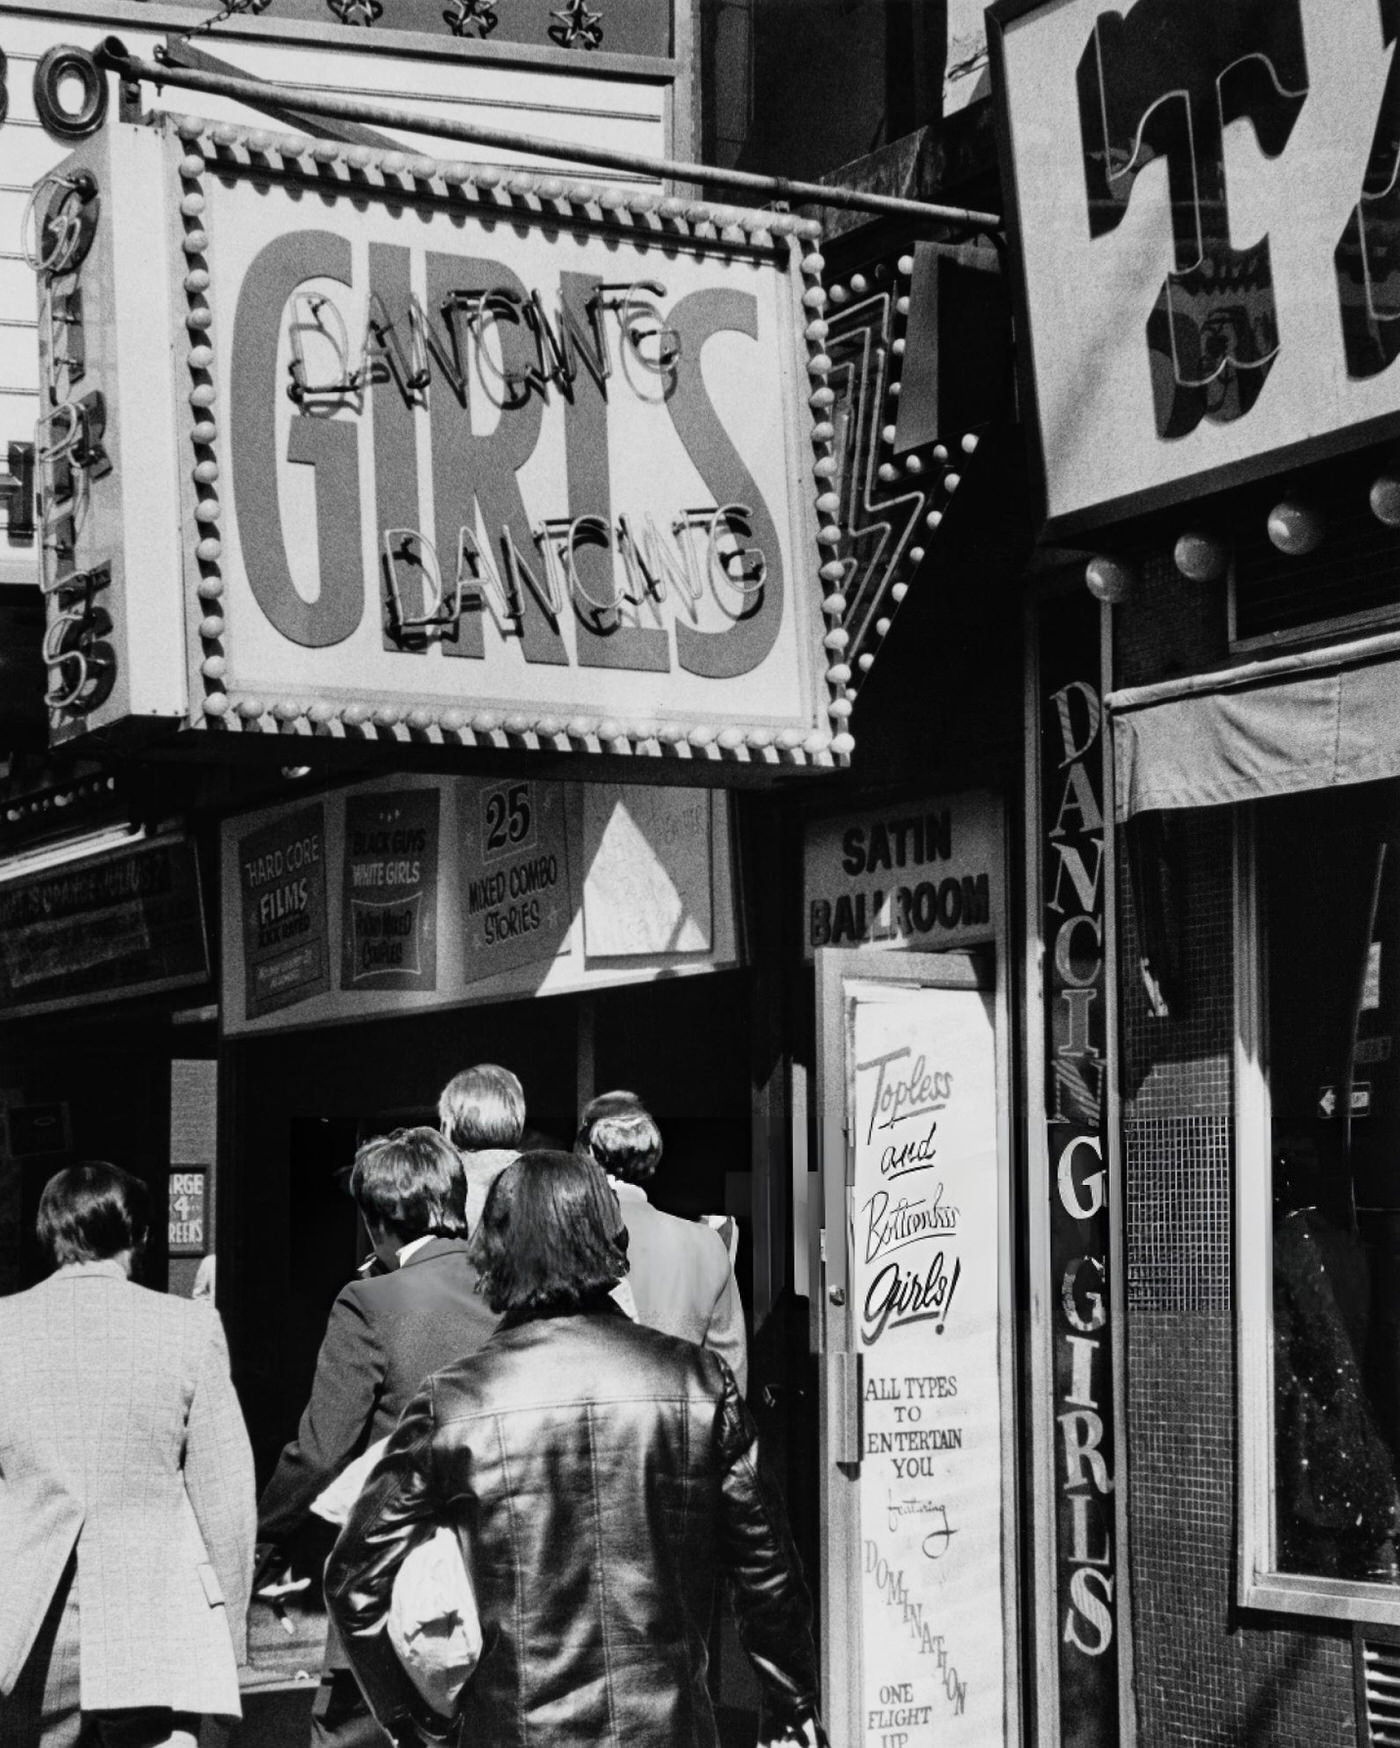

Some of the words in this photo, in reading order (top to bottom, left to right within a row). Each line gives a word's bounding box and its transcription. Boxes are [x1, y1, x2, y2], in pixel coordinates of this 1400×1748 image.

[287, 280, 682, 410] DANCING
[231, 229, 784, 679] GIRLS
[383, 504, 768, 632] DANCING
[485, 784, 531, 850] 25
[842, 811, 952, 877] SATIN
[246, 850, 283, 888] HARD
[286, 834, 320, 875] CORE
[352, 862, 384, 887] WHITE
[385, 860, 421, 886] GIRLS
[469, 872, 506, 916] MIXED
[509, 854, 558, 899] COMBO
[259, 877, 309, 925] FILMS
[484, 900, 541, 946] STORIES
[810, 873, 990, 947] BALLROOM
[1047, 681, 1107, 1221] DANCING
[857, 1046, 953, 1145] Topless
[880, 1121, 937, 1175] and
[864, 1377, 901, 1402] ALL
[904, 1375, 958, 1400] TYPES
[893, 1405, 922, 1423] TO
[866, 1428, 963, 1454] ENTERTAIN
[891, 1456, 935, 1479] YOU
[1055, 1254, 1115, 1656] GIRLS
[864, 1539, 968, 1716] DOMINATION
[867, 1705, 933, 1731] FLIGHT
[879, 1683, 914, 1705] ONE
[879, 1731, 910, 1748] UP
